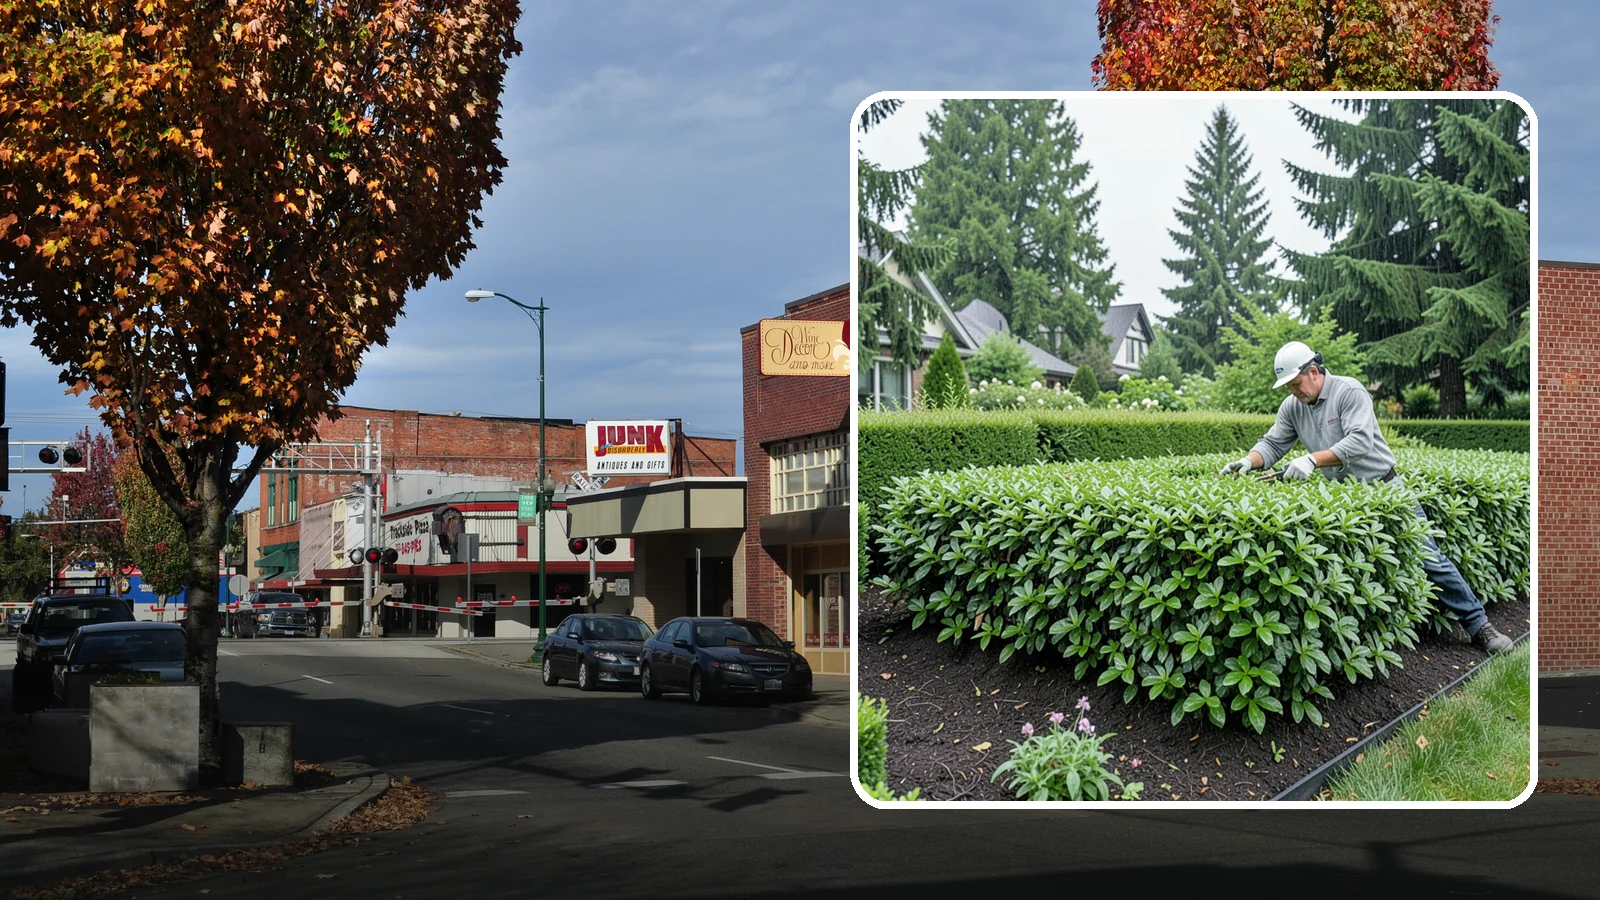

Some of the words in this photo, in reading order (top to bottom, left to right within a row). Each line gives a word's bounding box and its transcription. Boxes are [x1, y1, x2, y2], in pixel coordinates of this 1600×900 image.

[765, 327, 831, 366] Decor
[595, 425, 666, 457] JUNK
[607, 446, 646, 454] DISORDERLY
[597, 461, 628, 470] ANTIQUES
[631, 461, 644, 469] AND
[647, 460, 665, 469] GIFTS
[414, 519, 429, 535] Pizza
